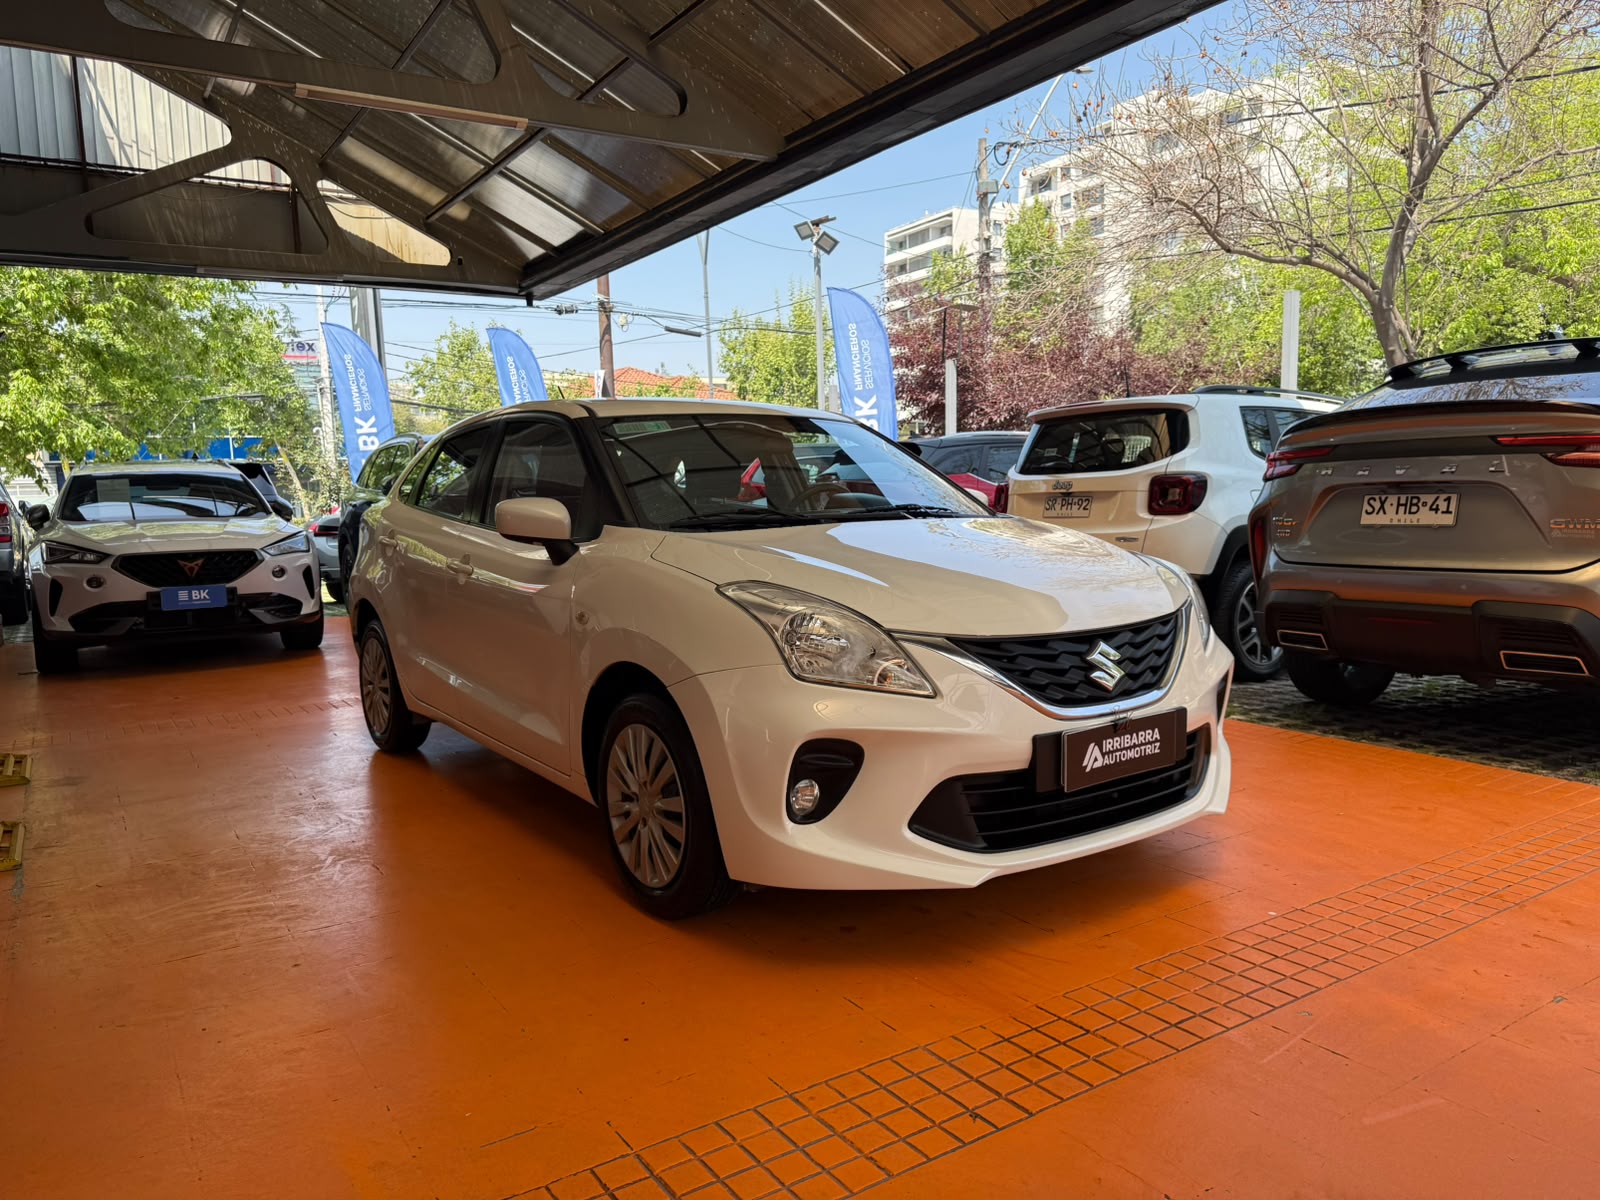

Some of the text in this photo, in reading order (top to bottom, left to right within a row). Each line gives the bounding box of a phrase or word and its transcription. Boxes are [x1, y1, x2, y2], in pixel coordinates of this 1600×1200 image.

[191, 589, 211, 600] BK
[1102, 727, 1160, 753] IRRIBARRA
[1102, 742, 1160, 767] AUTOMOTRIZ
